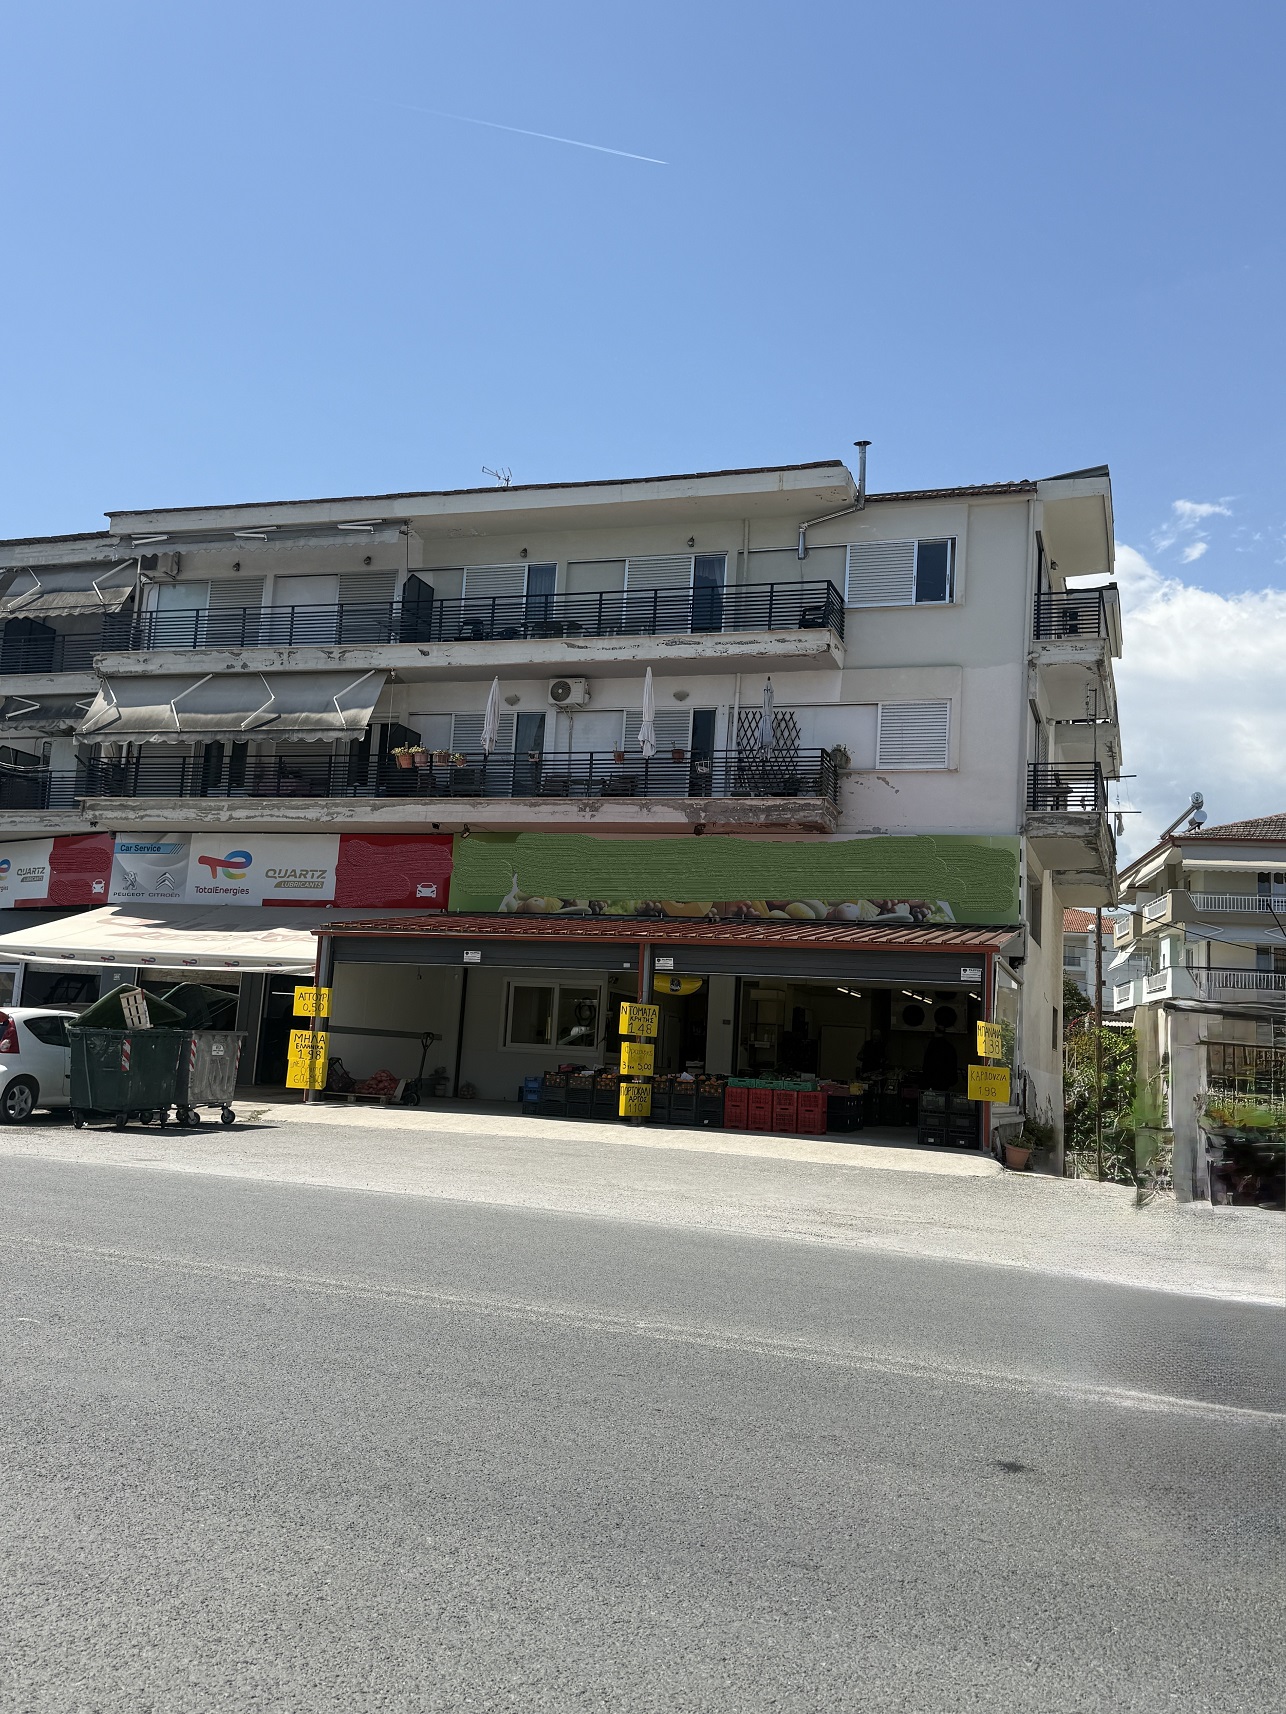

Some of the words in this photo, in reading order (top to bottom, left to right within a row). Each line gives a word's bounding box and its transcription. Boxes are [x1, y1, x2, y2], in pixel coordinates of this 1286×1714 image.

[120, 844, 133, 852] Car
[134, 844, 161, 852] Service
[16, 866, 46, 876] QUARTZ
[264, 868, 328, 880] QUARTZ
[194, 886, 250, 896] TotalEnergies
[297, 992, 330, 1003] ΑΓΓΟΥΡΙ
[302, 1003, 325, 1013] 0.50
[620, 1005, 657, 1018] ΝΤΟΜΑΤΑ
[293, 1033, 326, 1045] ΜΗΛΑ
